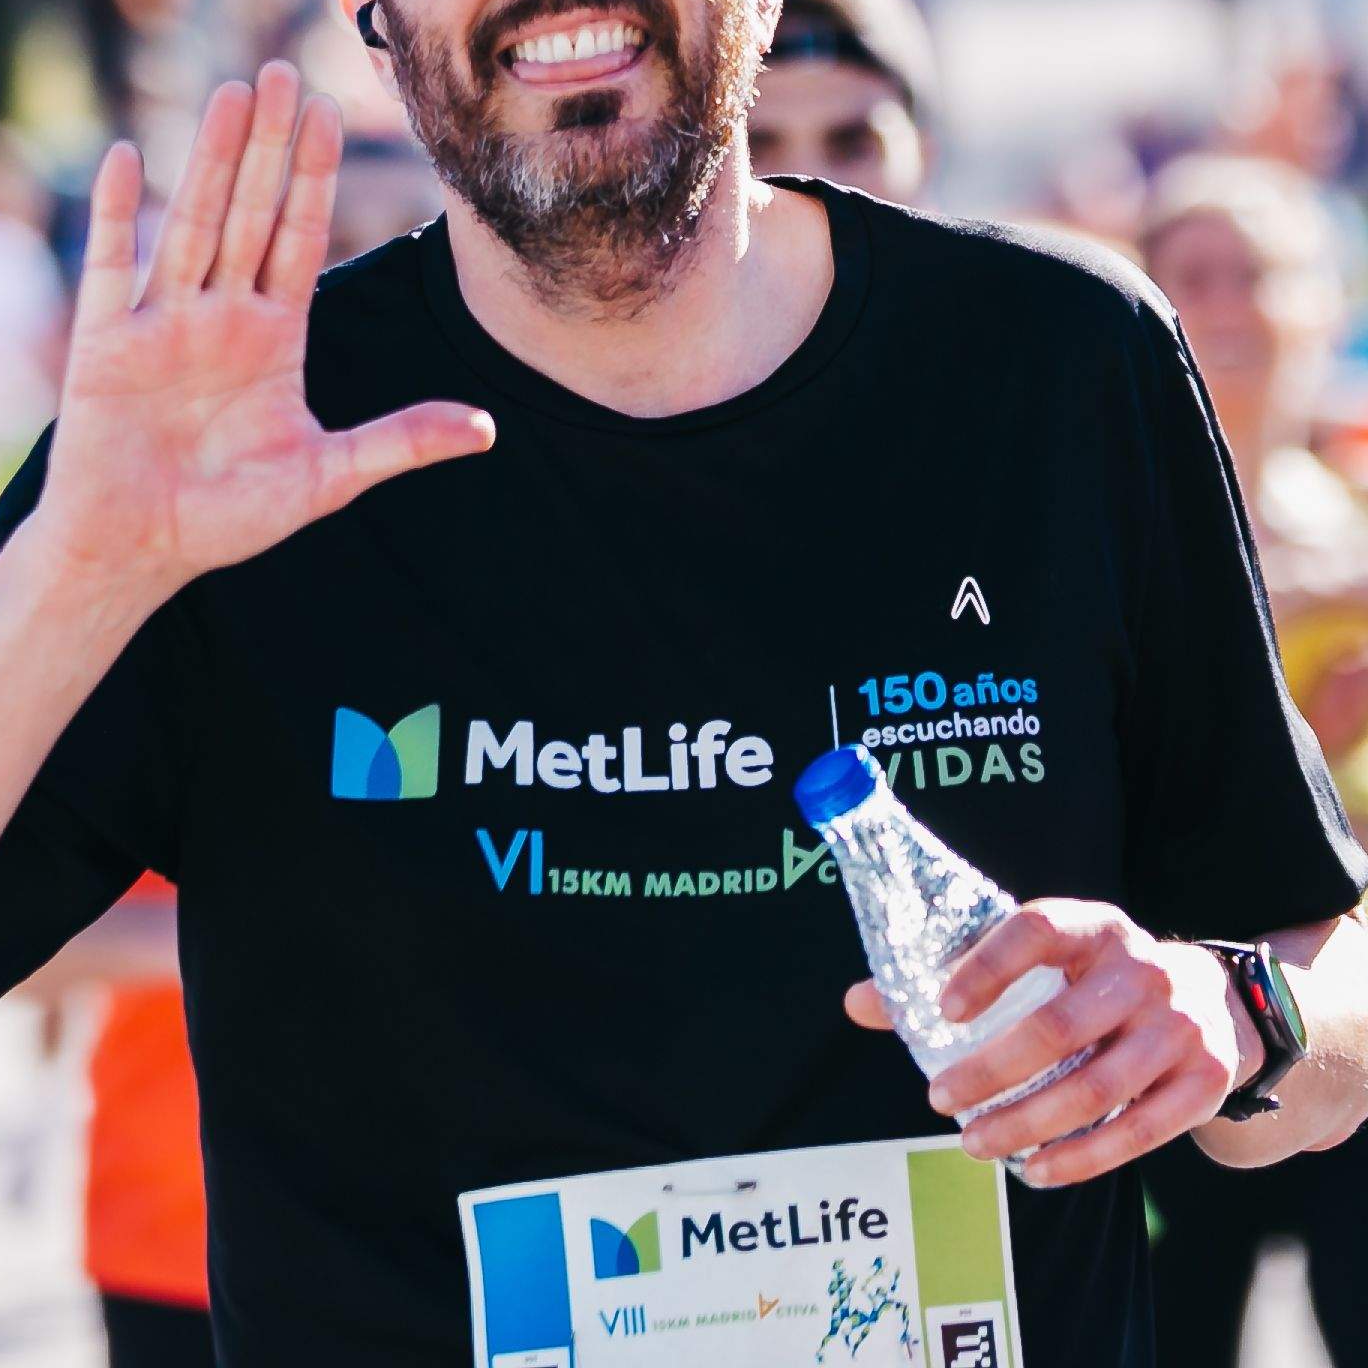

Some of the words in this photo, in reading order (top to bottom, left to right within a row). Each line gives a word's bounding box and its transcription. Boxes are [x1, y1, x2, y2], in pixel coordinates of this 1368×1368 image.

[858, 671, 947, 716] 150
[953, 672, 1038, 707] años
[861, 707, 1040, 748] escuchando
[465, 720, 773, 792] MetLife
[477, 828, 543, 895] VI
[548, 868, 631, 896] 15KM
[644, 867, 778, 897] MADRID
[681, 1197, 889, 1258] MetLife
[599, 1304, 646, 1335] VIII
